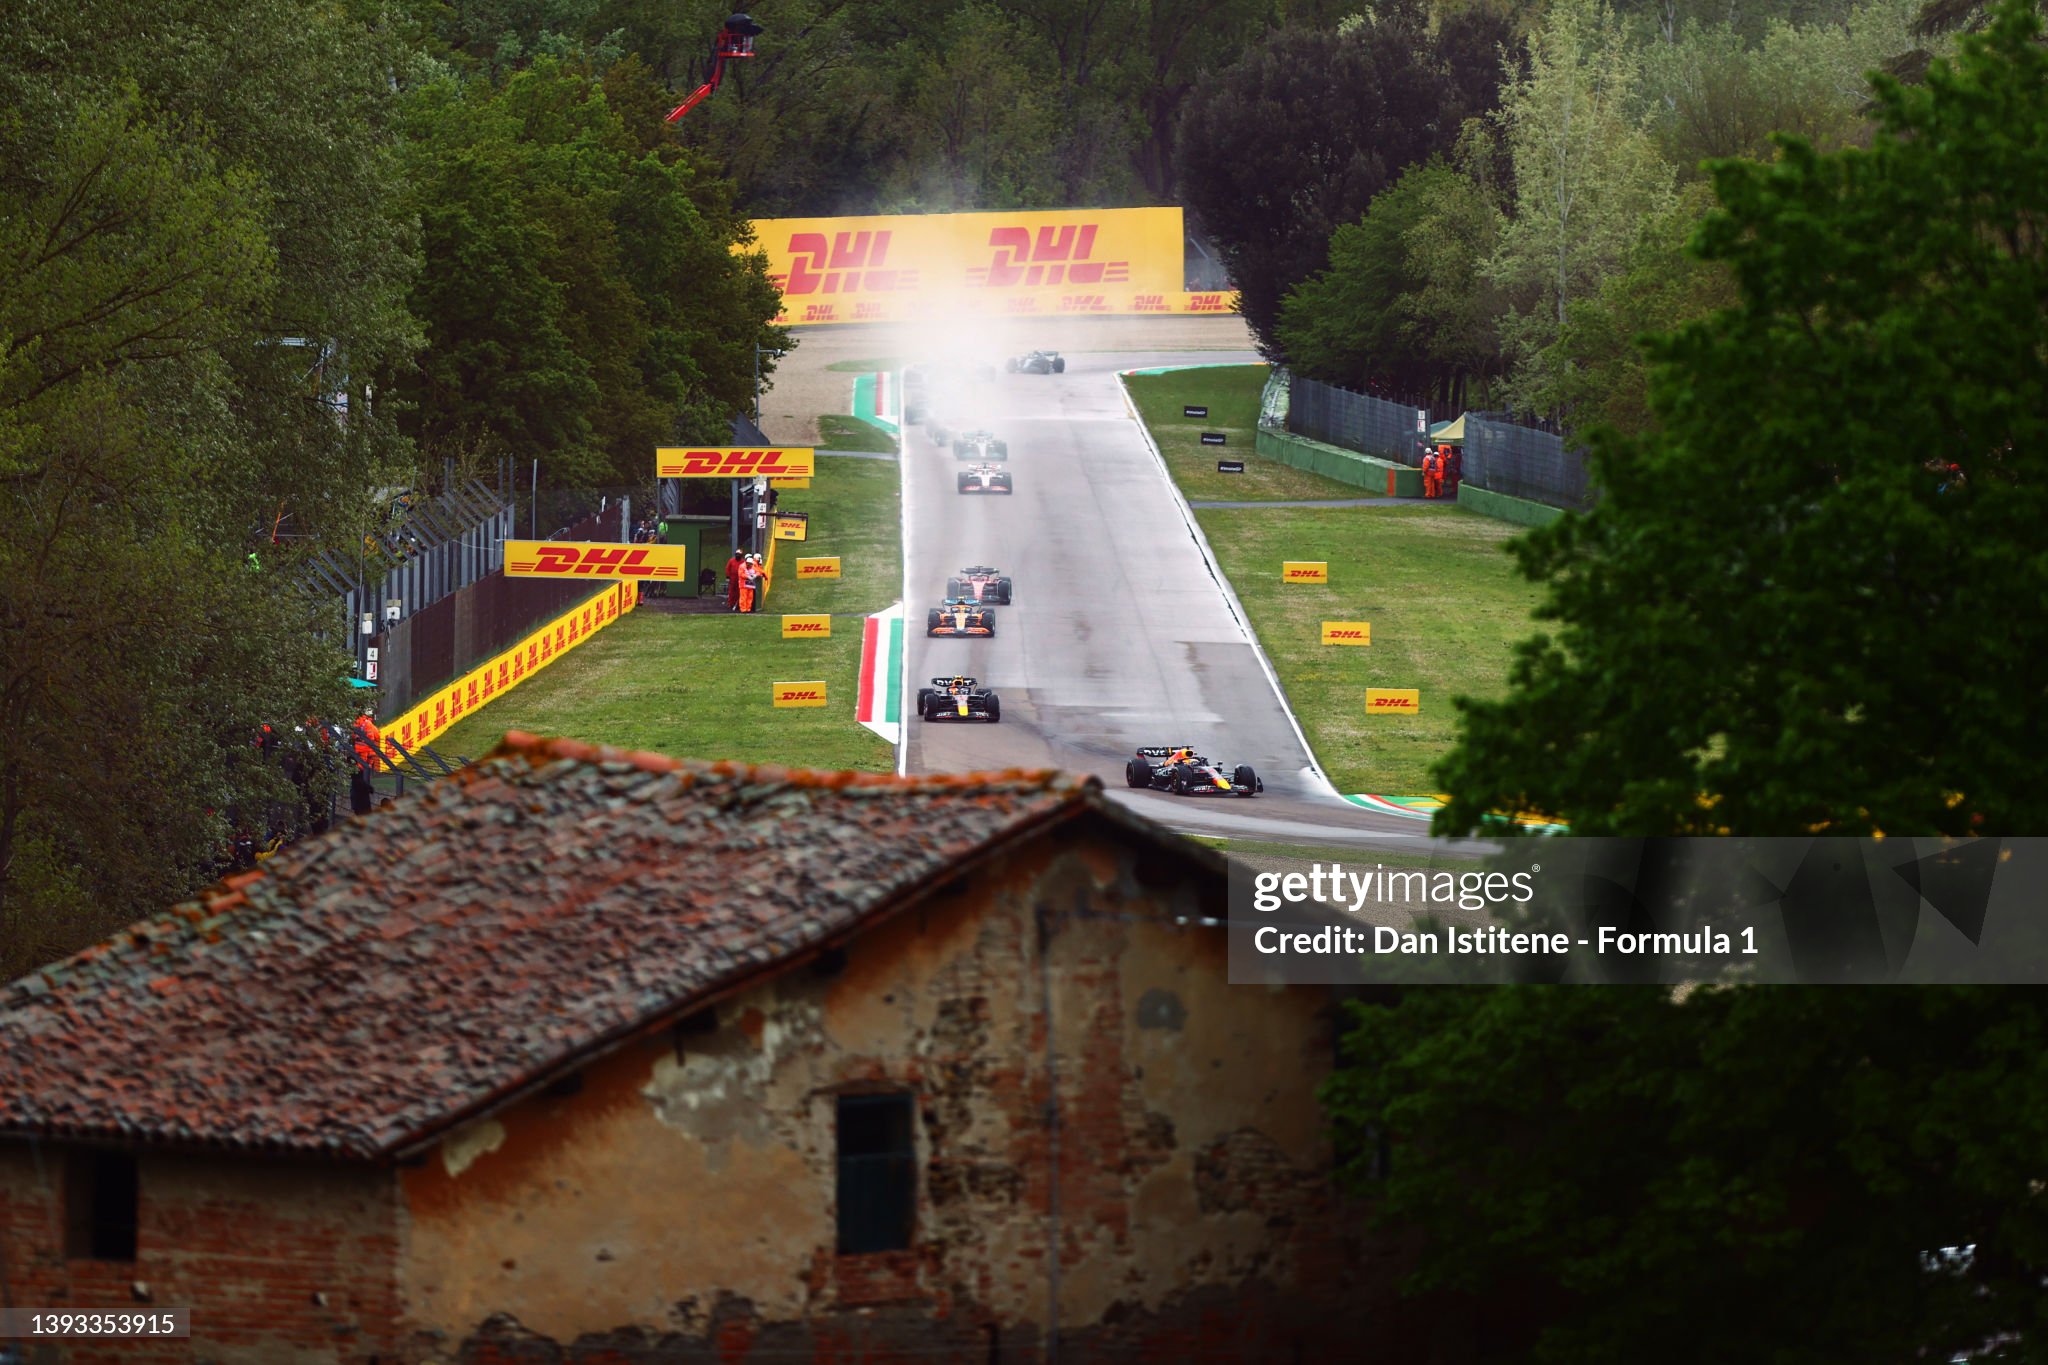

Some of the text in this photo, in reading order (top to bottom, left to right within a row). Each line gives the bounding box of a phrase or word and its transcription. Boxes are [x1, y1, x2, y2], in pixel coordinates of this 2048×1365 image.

[987, 224, 1106, 287] DHL
[785, 231, 898, 295] DHL
[1190, 296, 1222, 310] DHL
[682, 452, 789, 474] DHL
[533, 547, 657, 576] DHL
[803, 565, 833, 573] DHL
[789, 624, 823, 632] DHL
[1329, 630, 1363, 638] DHL
[782, 691, 818, 701] DHL
[1374, 698, 1411, 707] DHL
